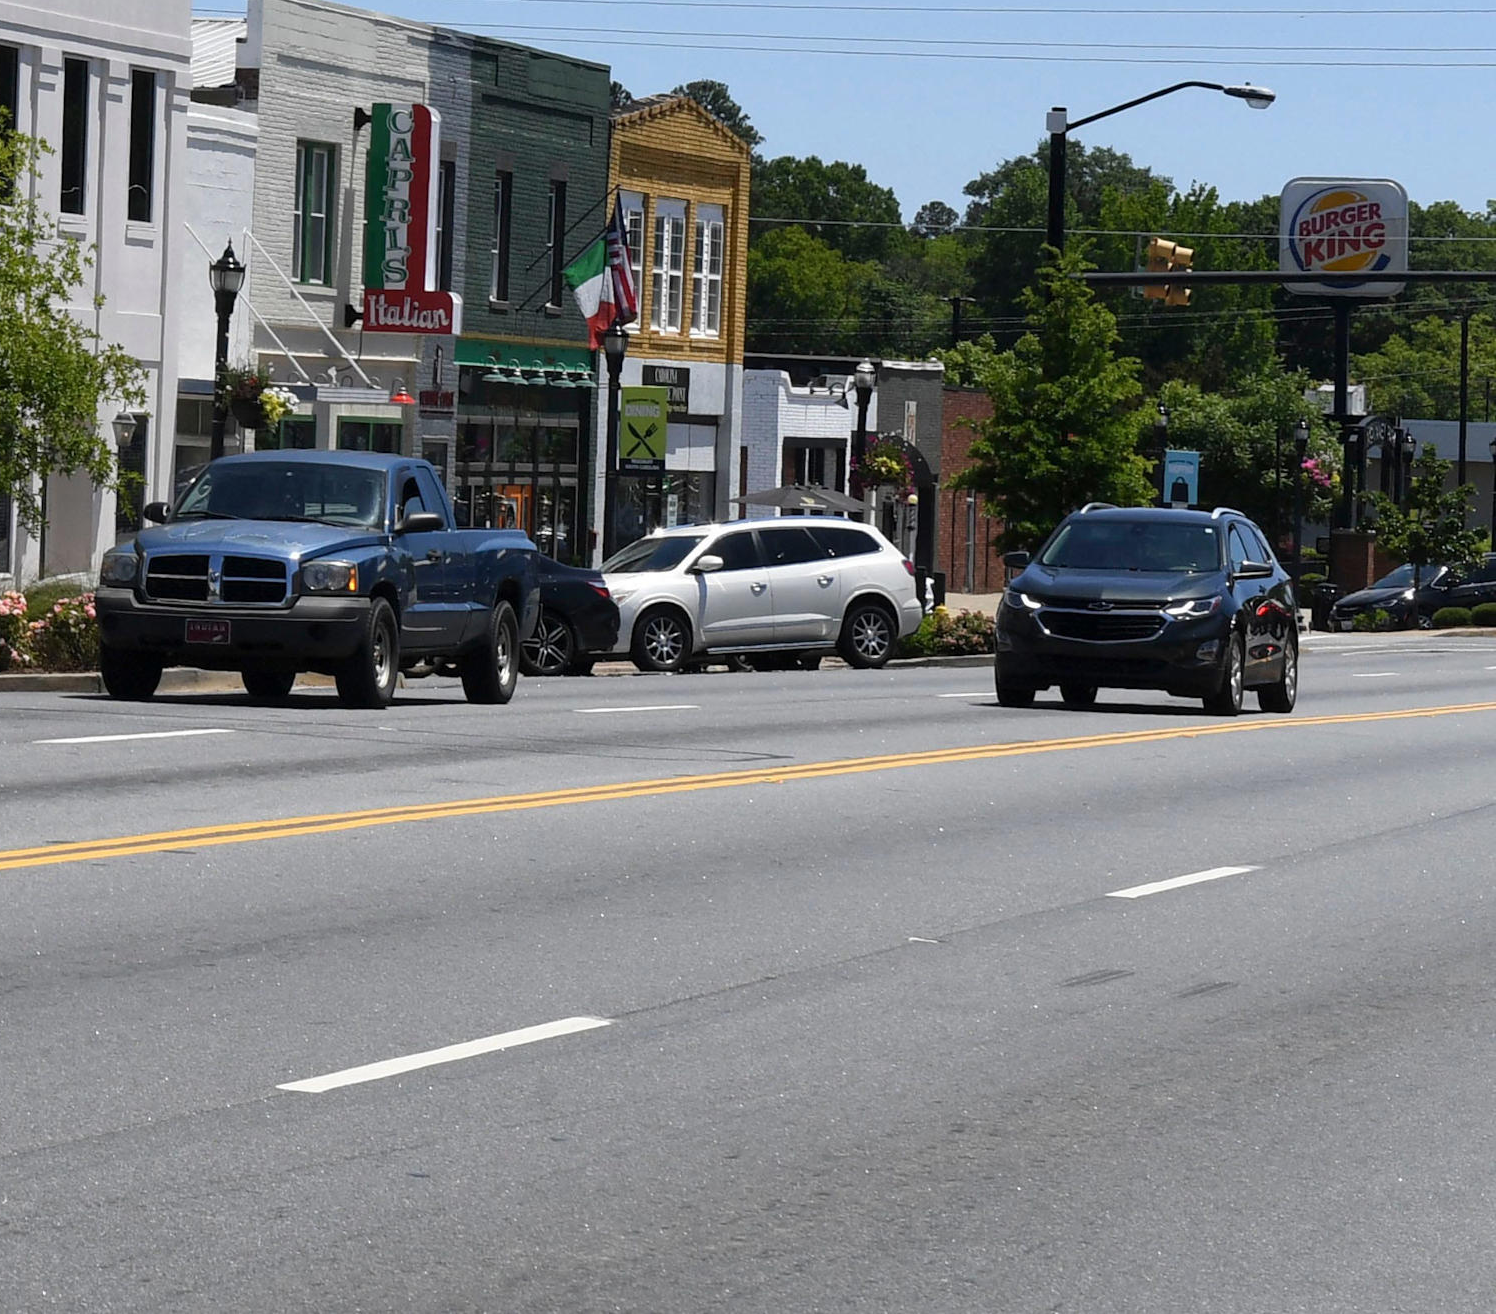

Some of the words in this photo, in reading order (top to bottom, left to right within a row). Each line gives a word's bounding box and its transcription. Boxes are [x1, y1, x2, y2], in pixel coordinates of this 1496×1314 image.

[379, 108, 416, 284] CAPRI'S
[1299, 202, 1382, 241] BURGER
[1304, 222, 1386, 268] KING
[367, 294, 451, 330] Italian
